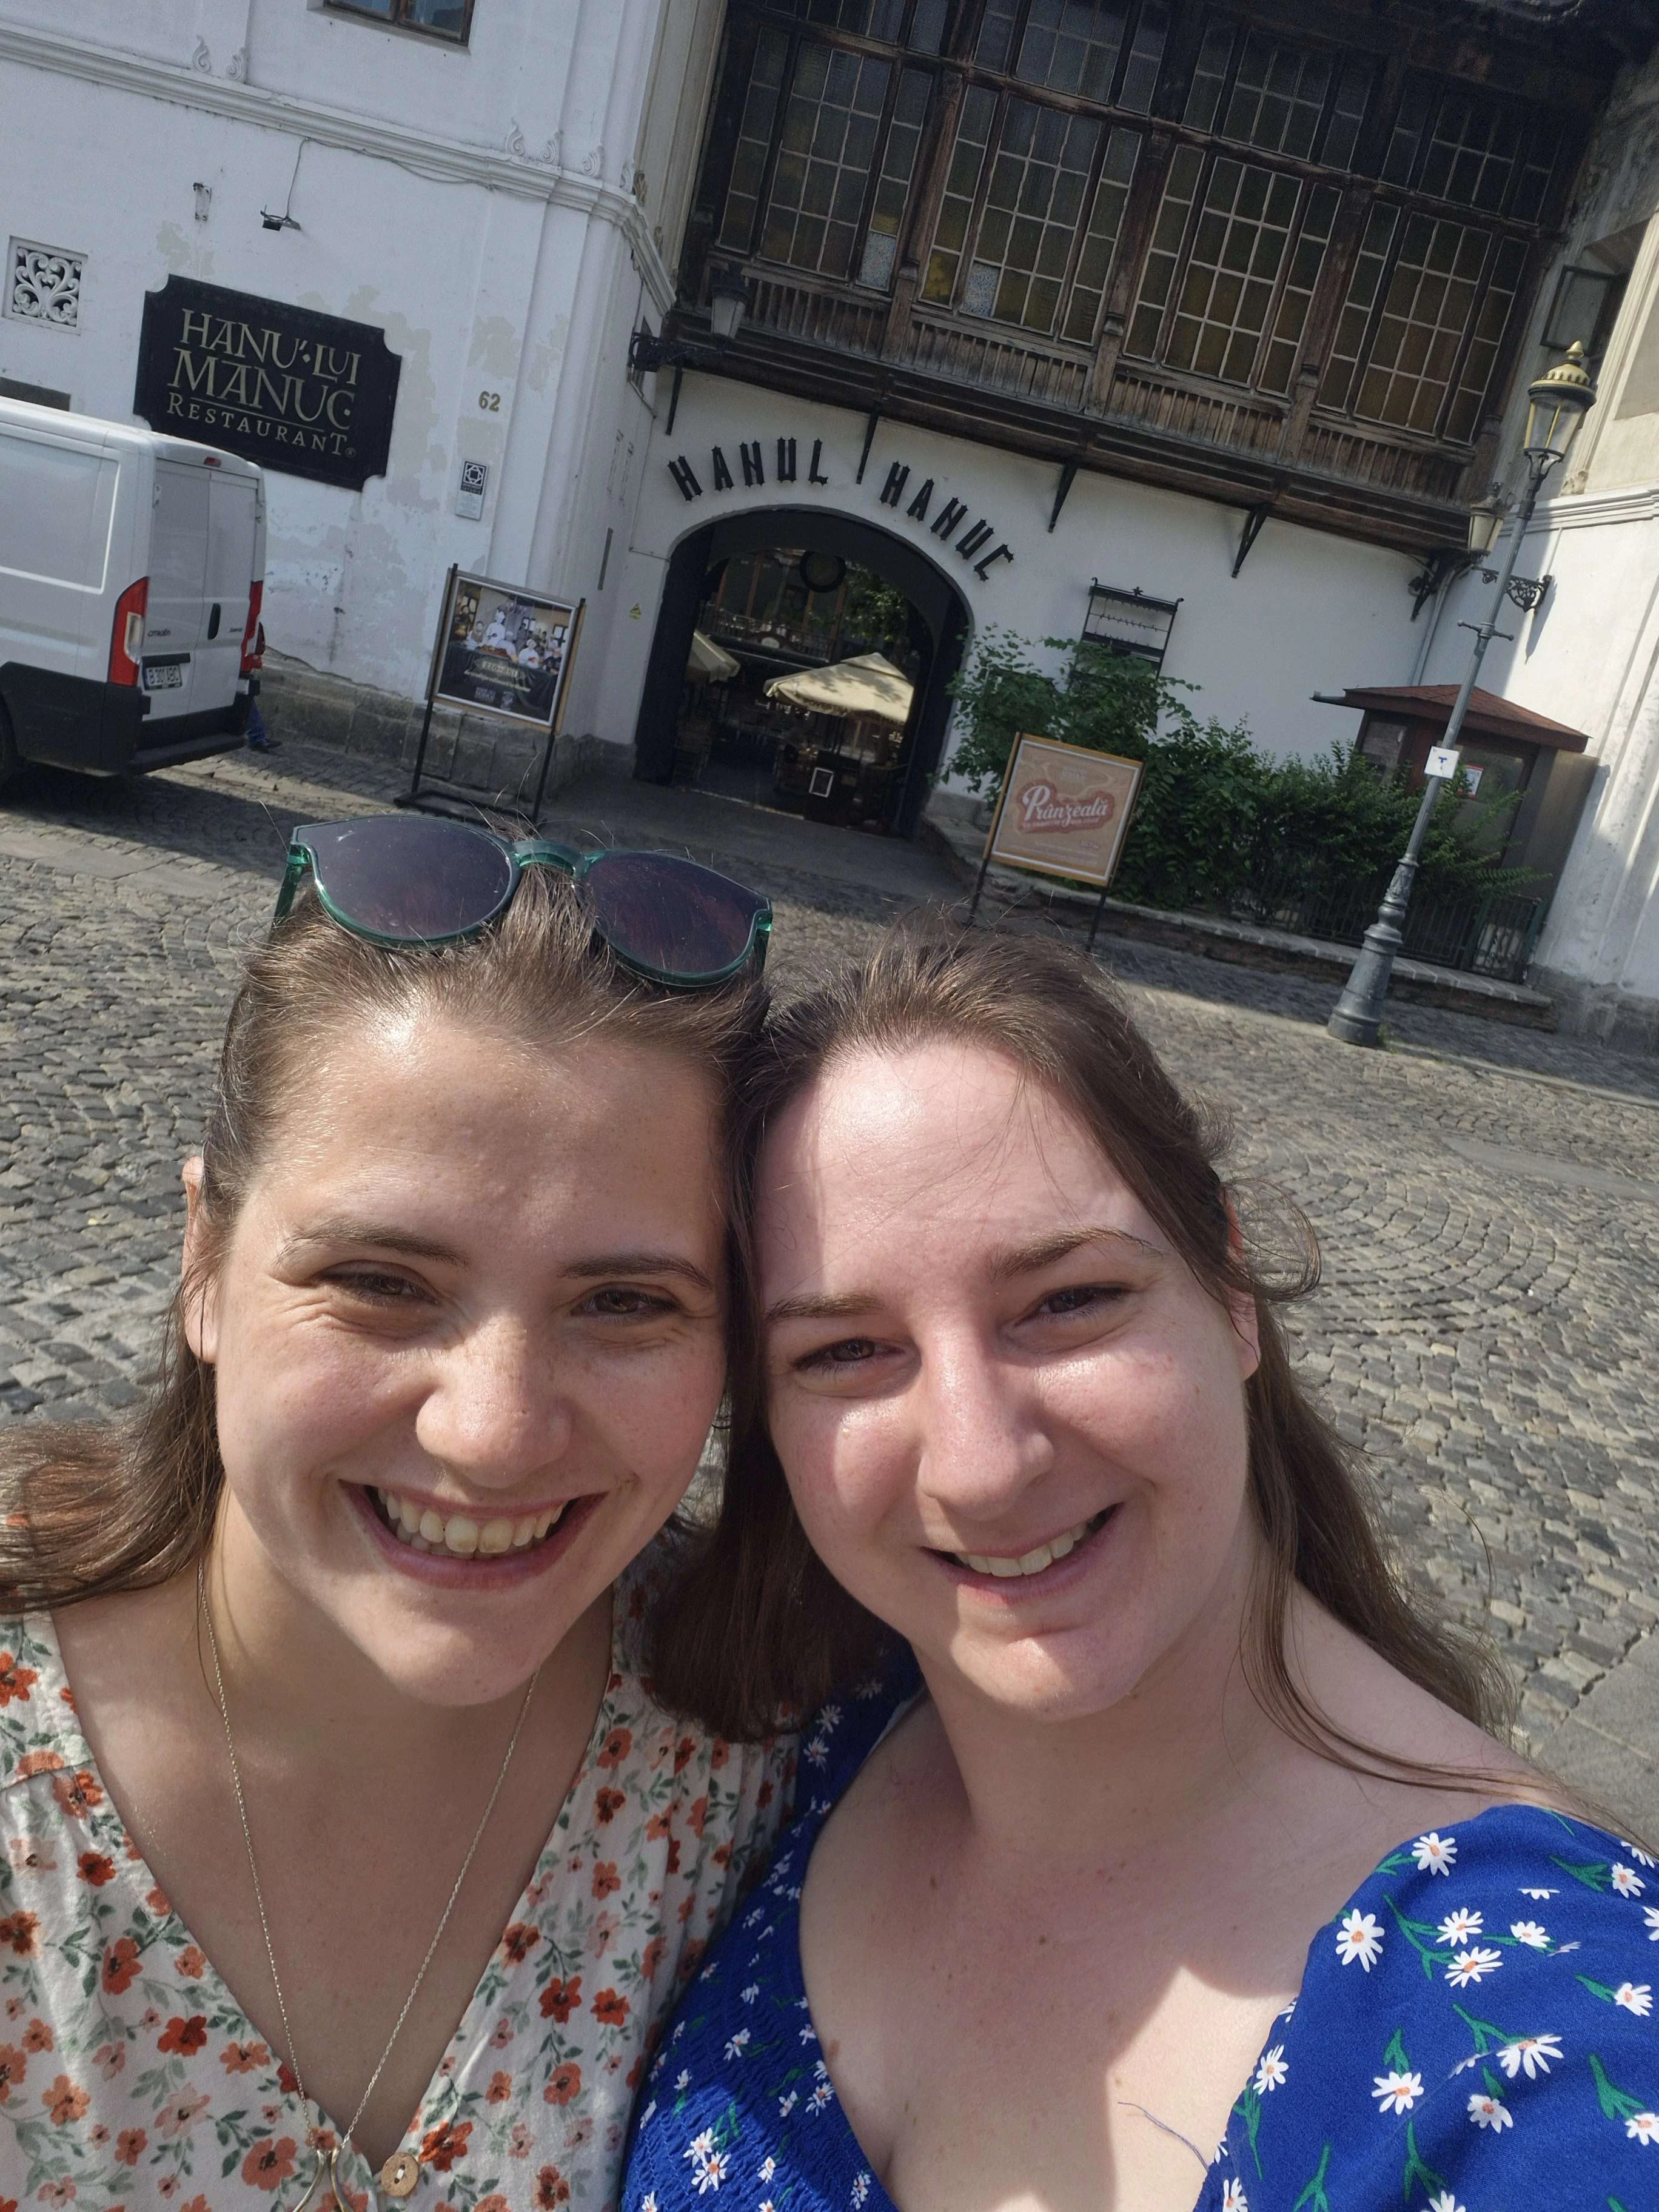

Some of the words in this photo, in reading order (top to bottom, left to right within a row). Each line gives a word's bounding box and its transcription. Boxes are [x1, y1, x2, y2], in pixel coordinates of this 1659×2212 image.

[167, 346, 355, 430] MANUC
[479, 391, 500, 412] 62
[667, 437, 829, 502] HANUL
